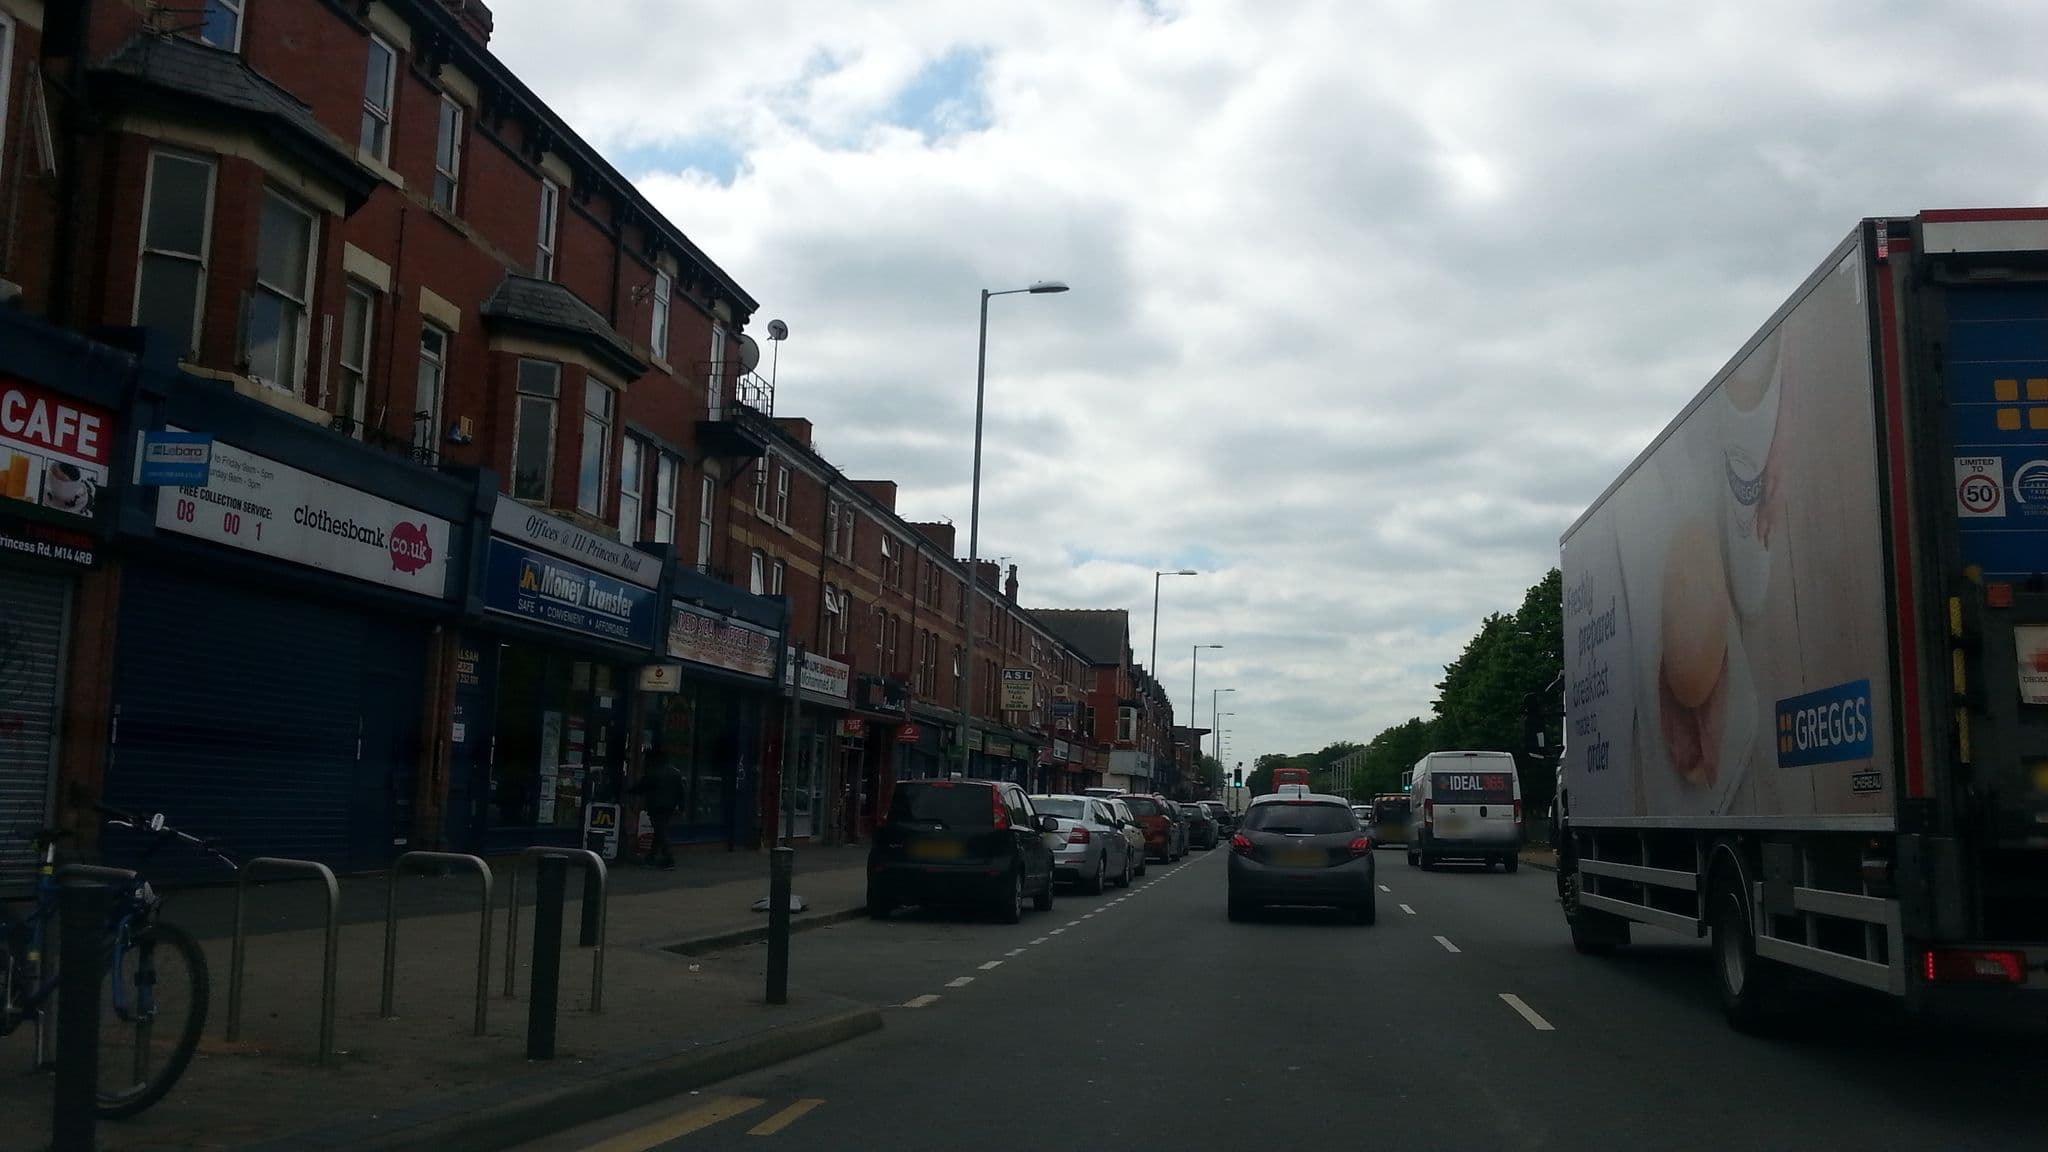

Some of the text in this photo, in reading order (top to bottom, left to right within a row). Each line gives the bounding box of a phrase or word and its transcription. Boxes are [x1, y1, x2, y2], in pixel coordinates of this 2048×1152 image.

[1, 389, 100, 457] CAFE
[163, 445, 202, 457] Lebara
[1960, 458, 1994, 466] LIMITED
[1972, 465, 1984, 473] TO
[179, 485, 272, 520] FREE COLLECTION SERVICE:
[1967, 485, 1992, 502] 50
[177, 499, 195, 522] 08
[224, 512, 240, 535] 00
[0, 536, 35, 553] rincess
[54, 545, 72, 560] M14
[74, 551, 93, 565] 4RB
[526, 515, 558, 539] Offices
[587, 539, 619, 564] Princess
[621, 552, 642, 572] Road
[541, 564, 585, 605] Money
[588, 579, 633, 617] Transfer
[518, 599, 629, 638] SAFE CONVENIENT AFFORDABLE
[1579, 595, 1615, 662] prepared
[1796, 696, 1867, 750] GREGGS
[1587, 731, 1609, 773] order
